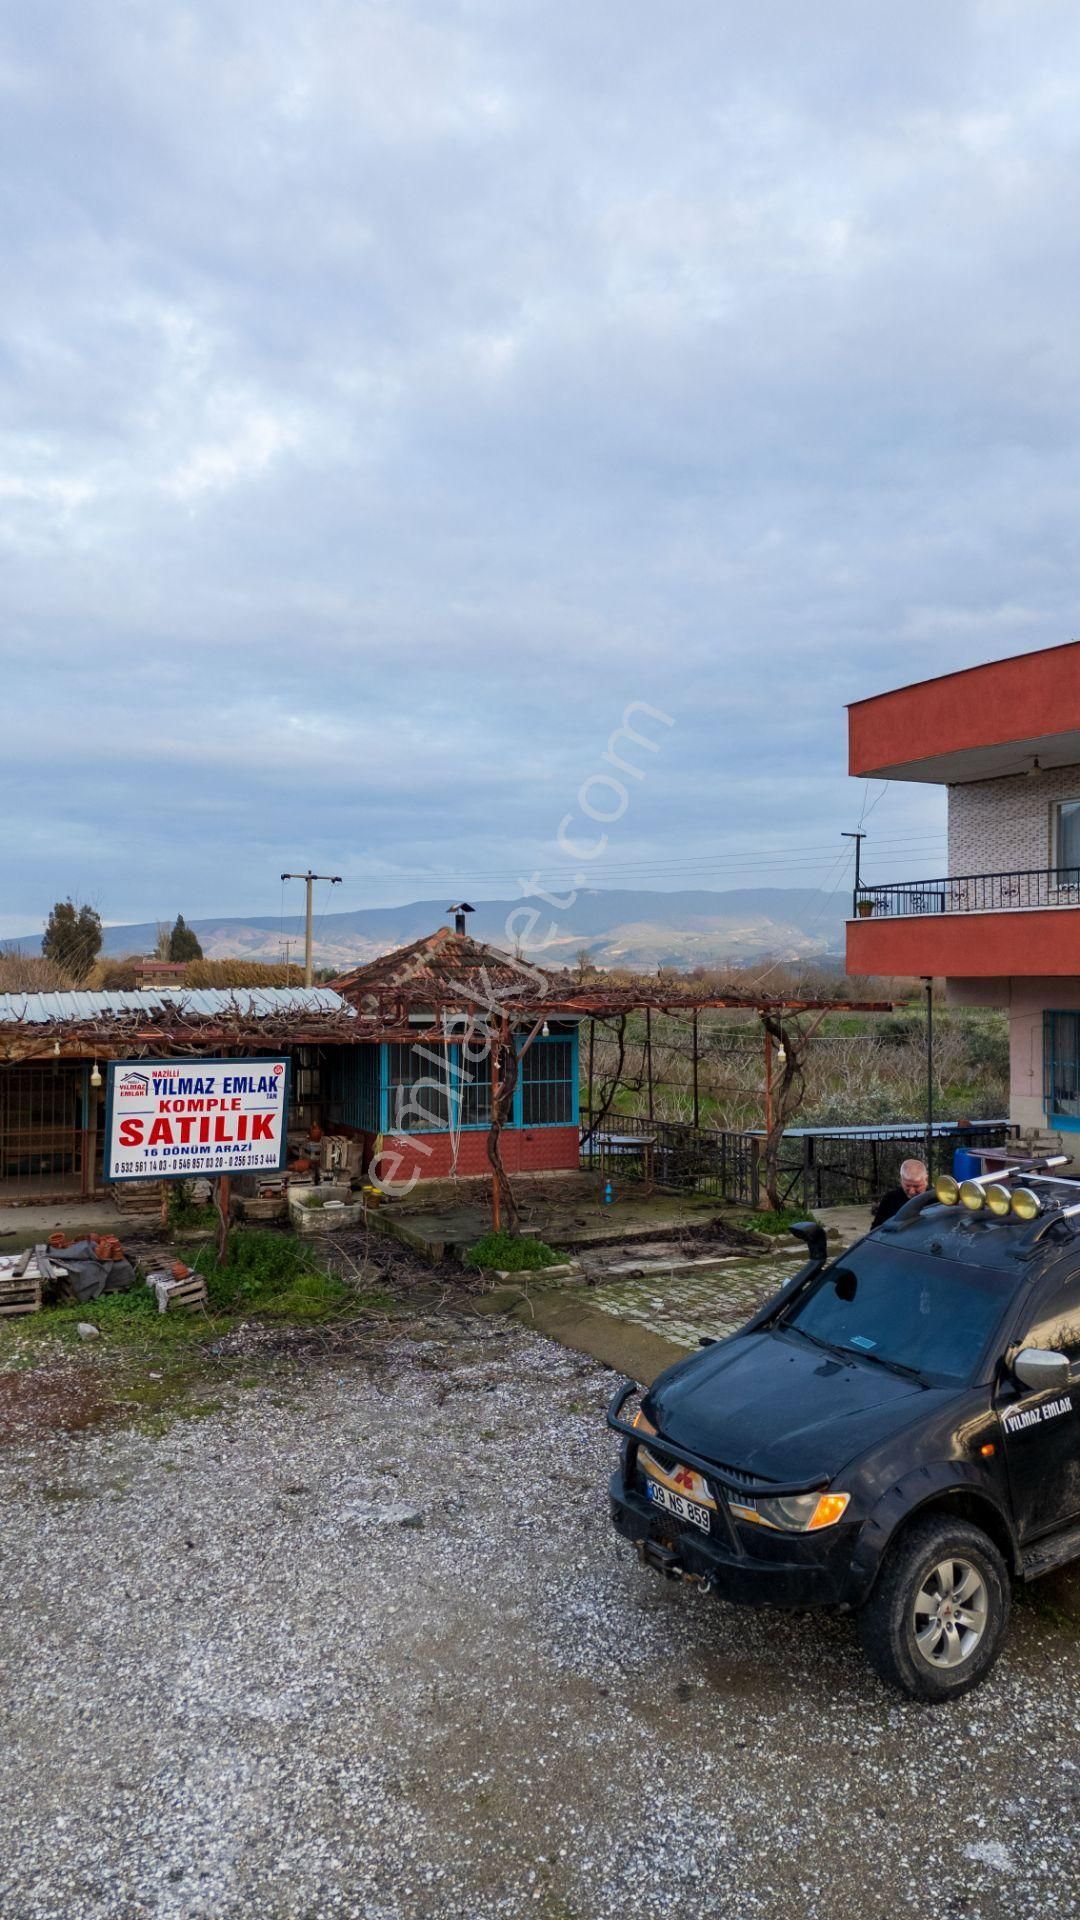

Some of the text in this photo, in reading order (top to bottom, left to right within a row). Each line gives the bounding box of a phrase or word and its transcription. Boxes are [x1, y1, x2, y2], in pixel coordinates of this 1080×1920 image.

[153, 1075, 279, 1096] YILMAZ EMLAK
[159, 1098, 242, 1113] KOMPLE
[119, 1113, 276, 1147] SATILIK
[143, 1143, 252, 1157] 16 DÖNÜM ARAZİ
[1008, 1396, 1073, 1432] YILMAZ EMLAK
[652, 1484, 709, 1528] 09 NS 859
